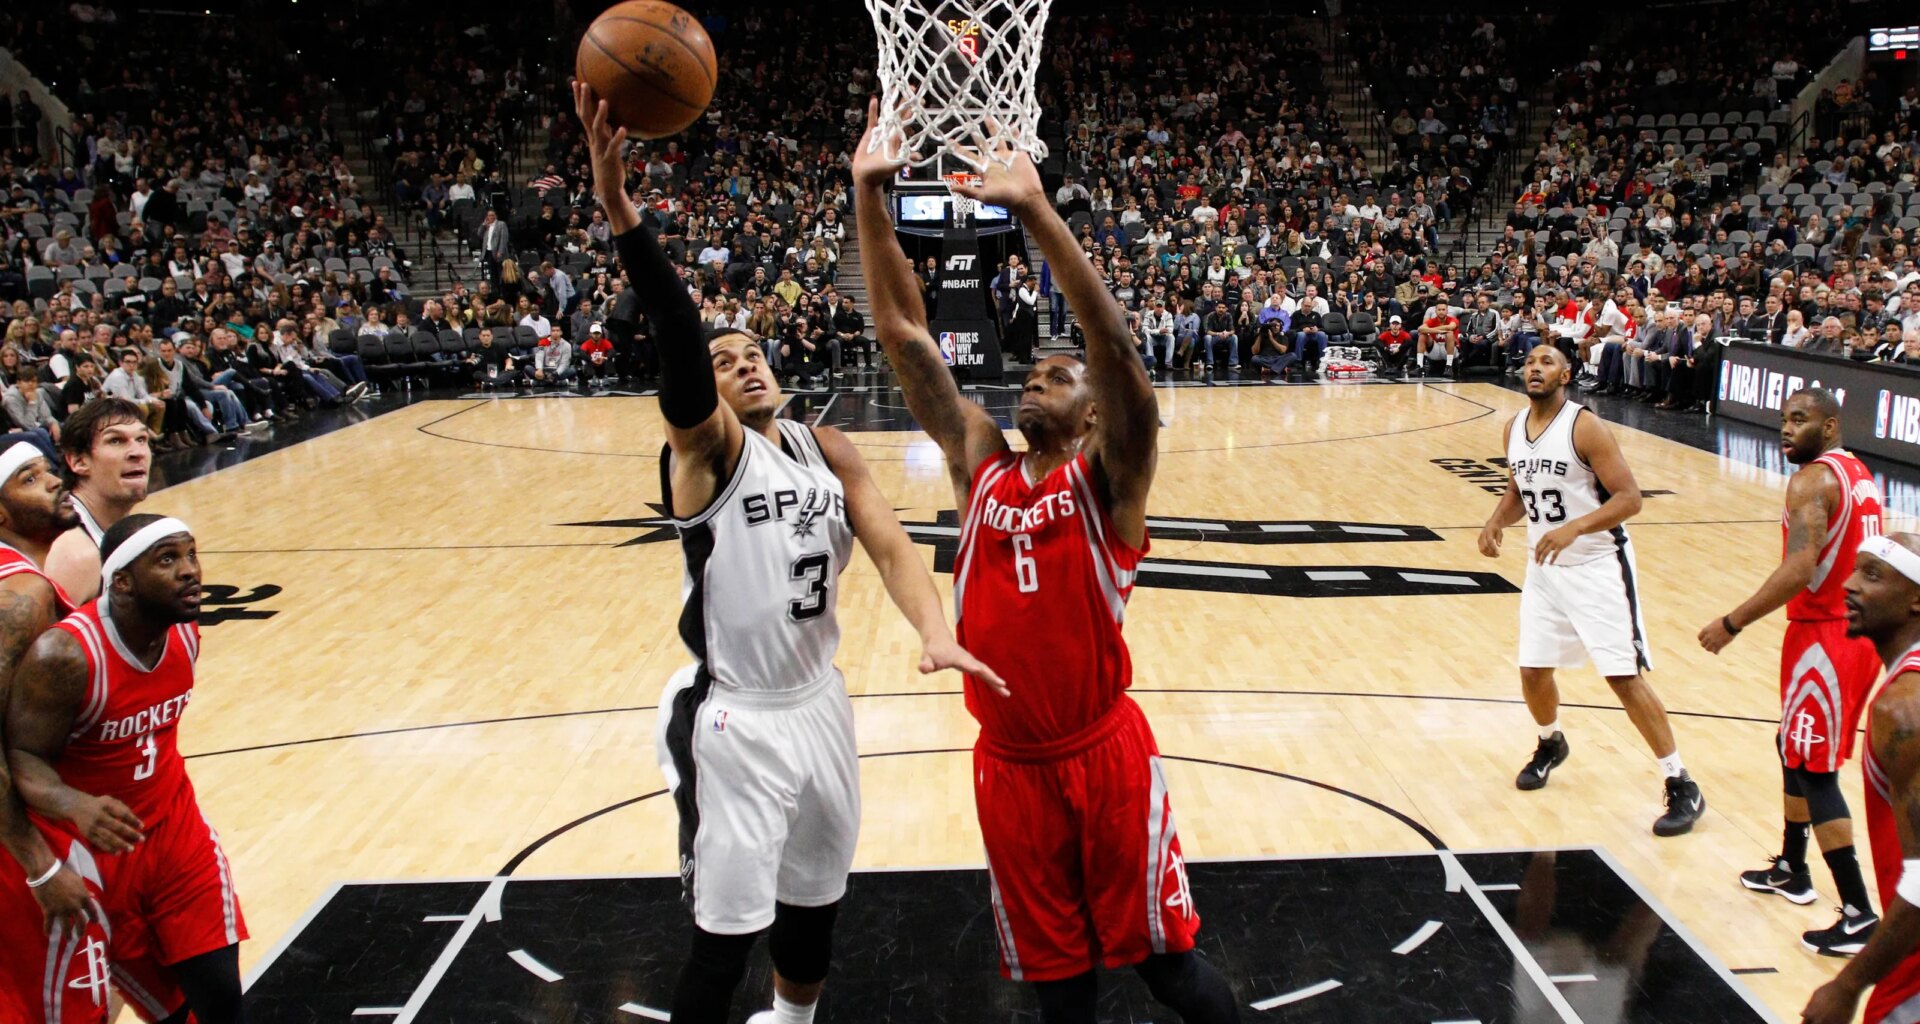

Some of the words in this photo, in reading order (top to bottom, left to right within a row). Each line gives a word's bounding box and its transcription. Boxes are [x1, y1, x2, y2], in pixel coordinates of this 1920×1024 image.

[942, 279, 980, 289] #NBAFIT
[956, 332, 971, 343] THIS
[971, 332, 979, 343] IS
[956, 343, 972, 354] WHY
[957, 354, 968, 365] WE
[968, 353, 985, 365] PLAY
[1729, 363, 1760, 406] NBA
[1890, 394, 1920, 445] NB
[1429, 458, 1509, 497] CENTE
[742, 488, 845, 526] SPUR
[982, 490, 1075, 533] ROCKETS
[1521, 488, 1567, 523] 33
[1011, 533, 1039, 594] 6
[788, 550, 830, 624] 3
[133, 731, 158, 781] 3
